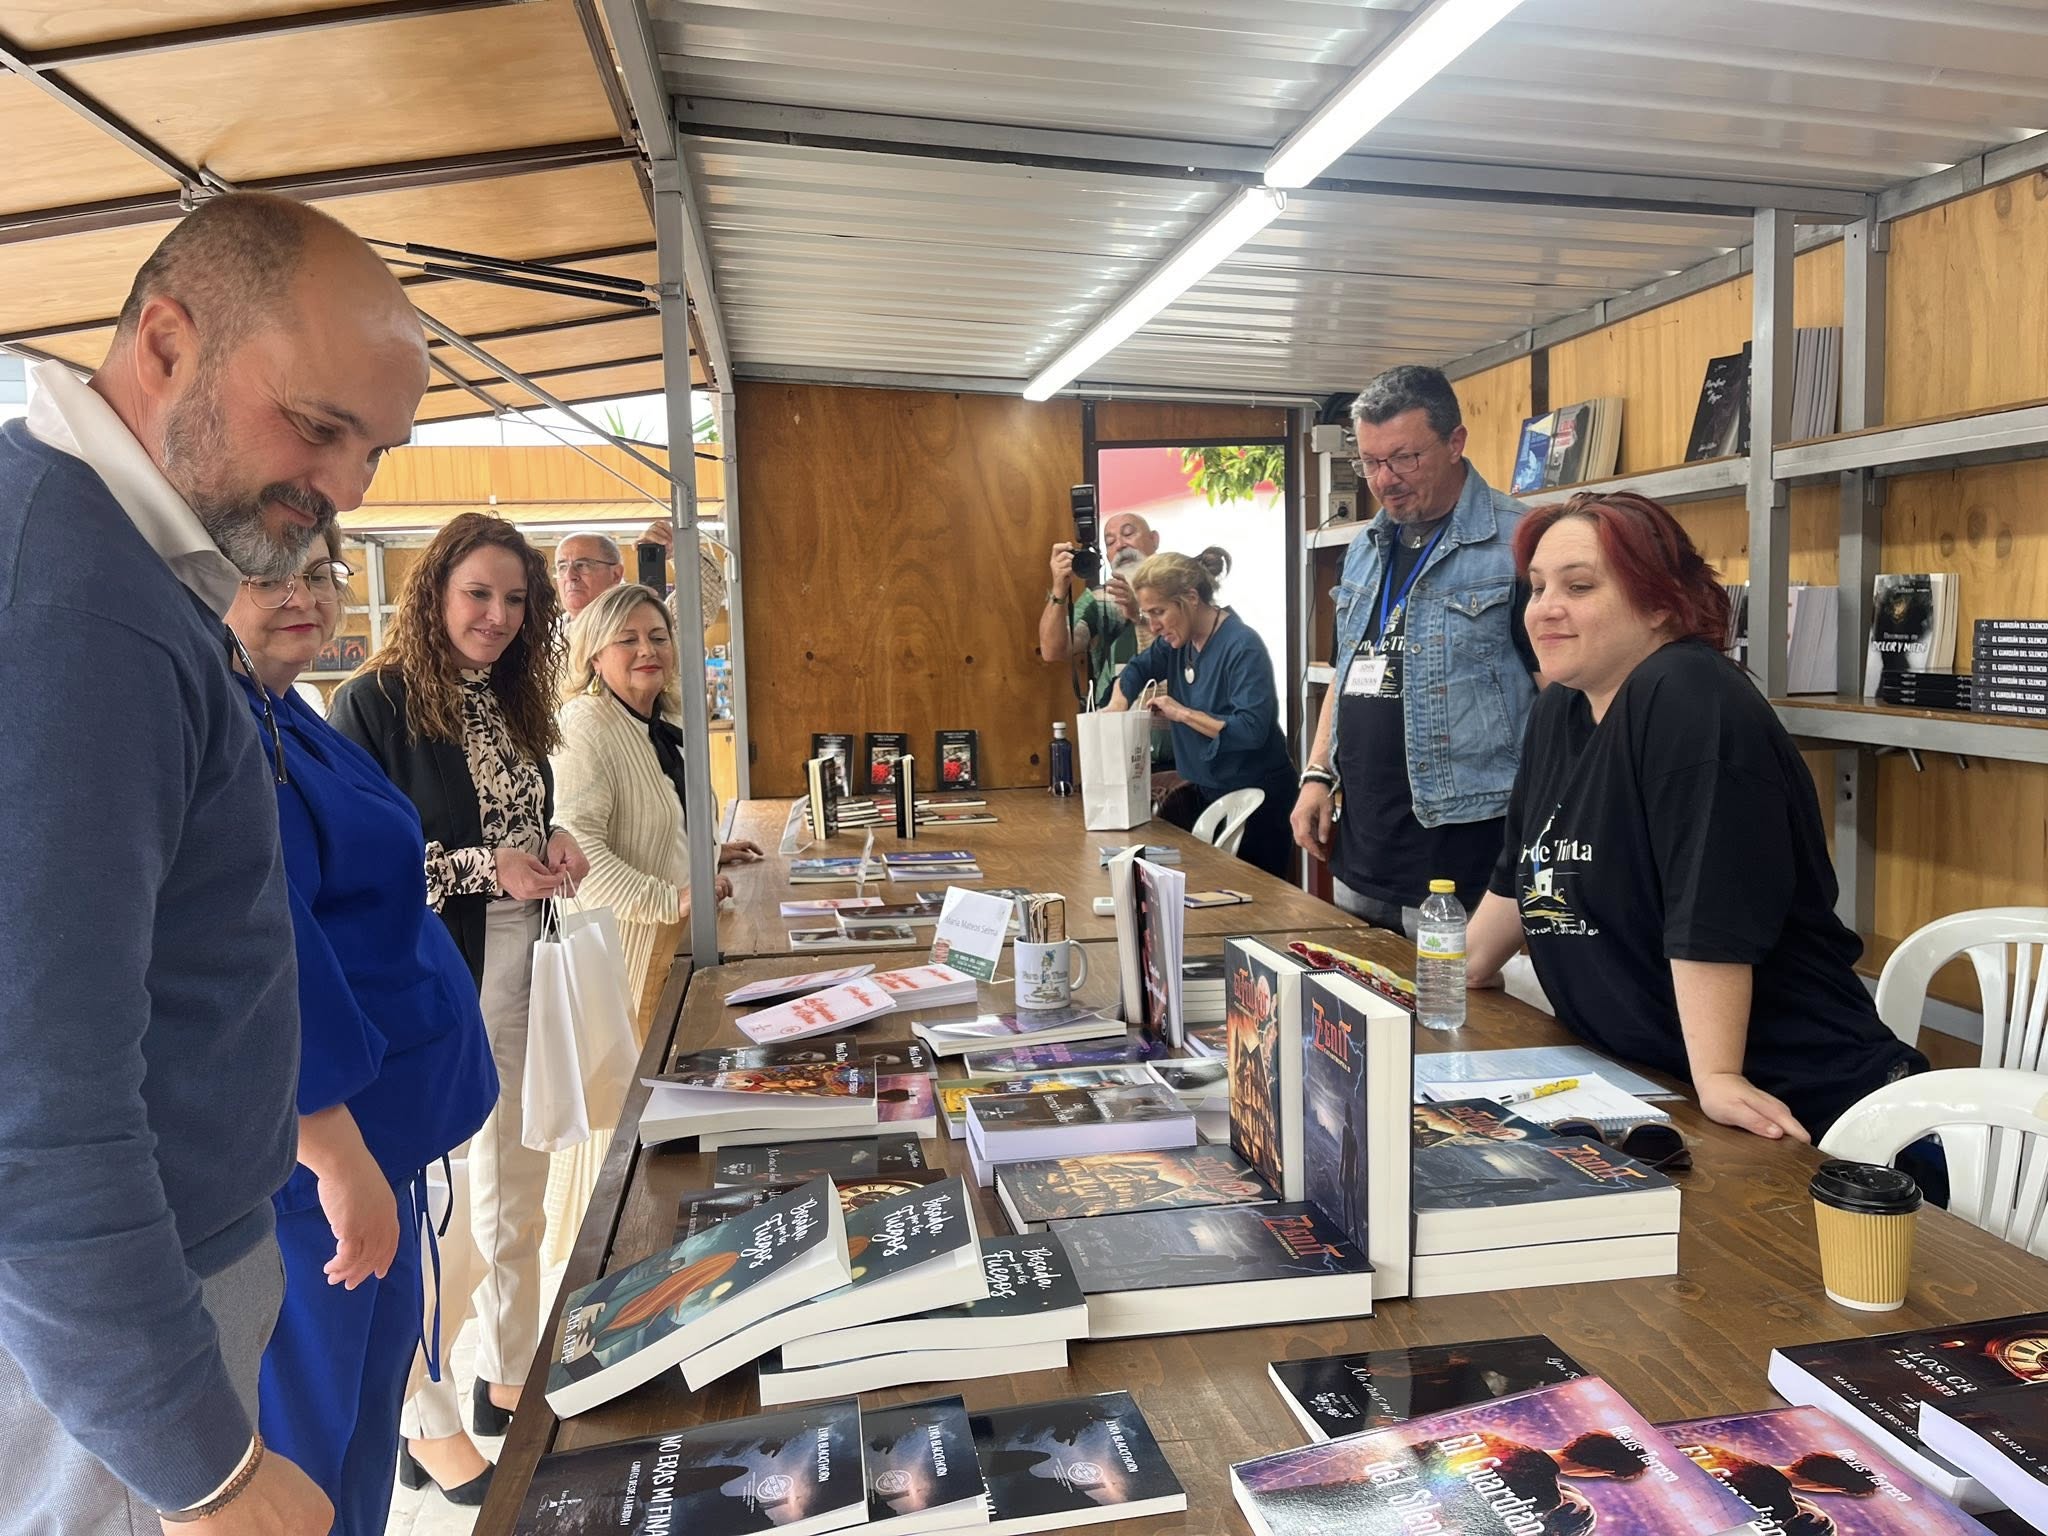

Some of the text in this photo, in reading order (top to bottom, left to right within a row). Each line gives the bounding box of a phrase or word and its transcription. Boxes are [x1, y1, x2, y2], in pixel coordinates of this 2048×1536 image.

[741, 1213, 782, 1268] Fuegos
[872, 1204, 914, 1257] Fuegos
[1344, 1364, 1371, 1381] No
[1895, 1358, 1917, 1371] DE
[1906, 1351, 1950, 1374] LOS
[658, 1434, 684, 1453] NO
[817, 1427, 830, 1483] LYRA BLACKTHORN
[928, 1425, 948, 1477] LYRA BLACKTHORN
[1105, 1420, 1139, 1473] LYRA BLACKTHORN
[1436, 1432, 1487, 1456] El
[652, 1454, 680, 1485] ERAS
[1363, 1460, 1419, 1488] del
[650, 1486, 674, 1504] MI
[1459, 1457, 1547, 1536] Guardián
[1389, 1489, 1450, 1536] Silen
